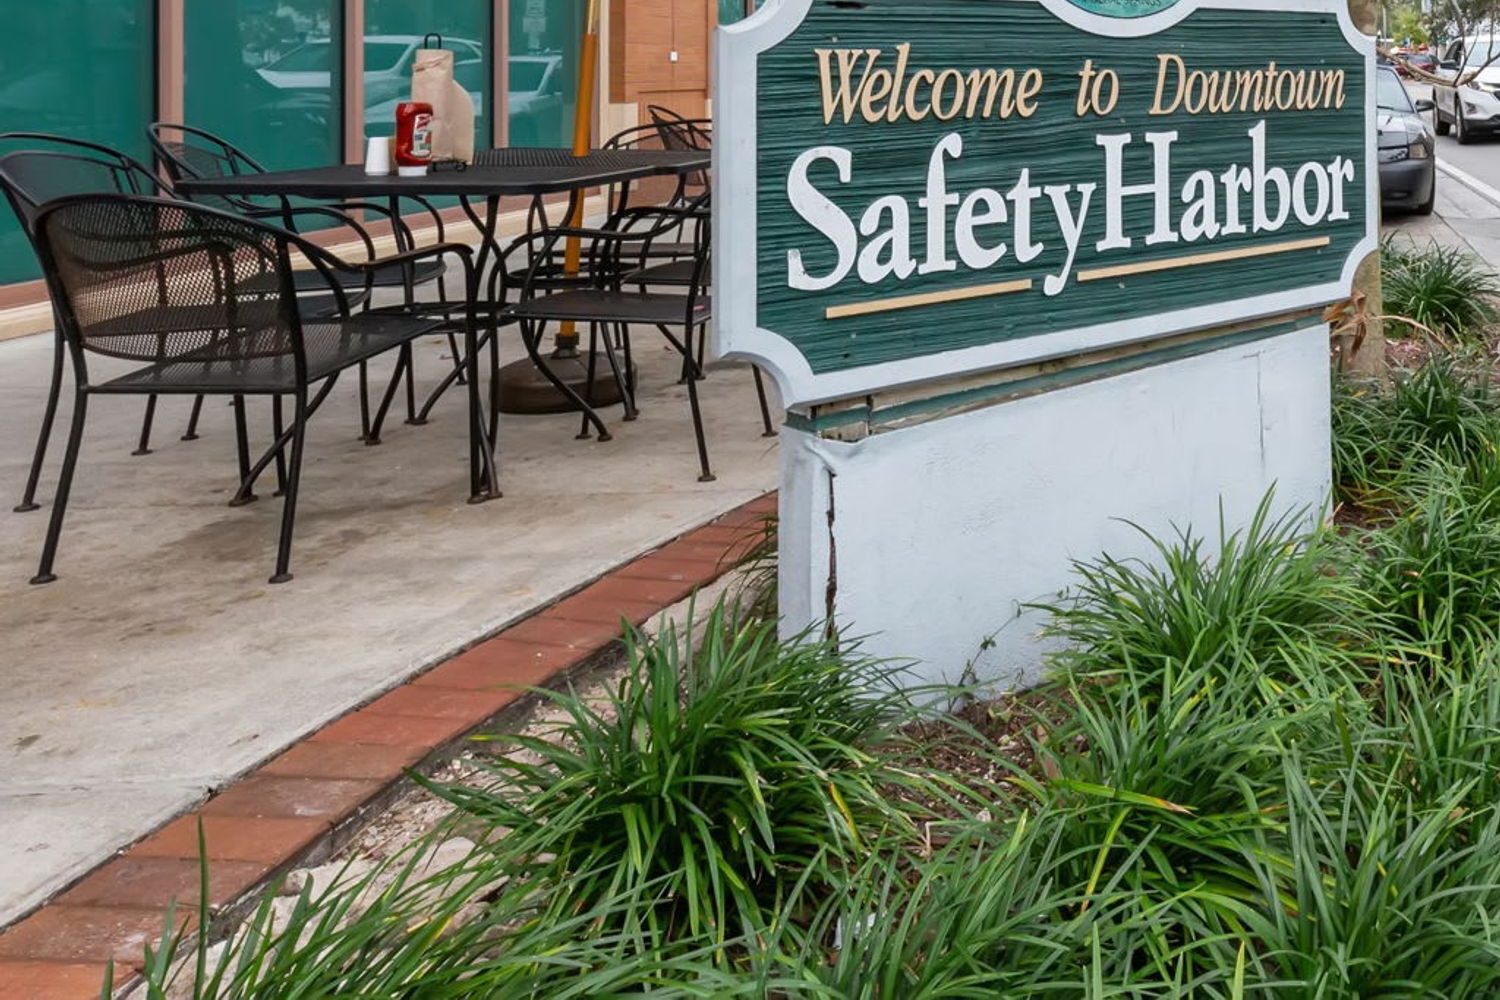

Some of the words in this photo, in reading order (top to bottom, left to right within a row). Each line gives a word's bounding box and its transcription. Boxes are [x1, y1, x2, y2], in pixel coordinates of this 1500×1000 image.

[813, 42, 1044, 126] Welcome
[1075, 58, 1120, 117] to
[1148, 53, 1348, 117] Downtown
